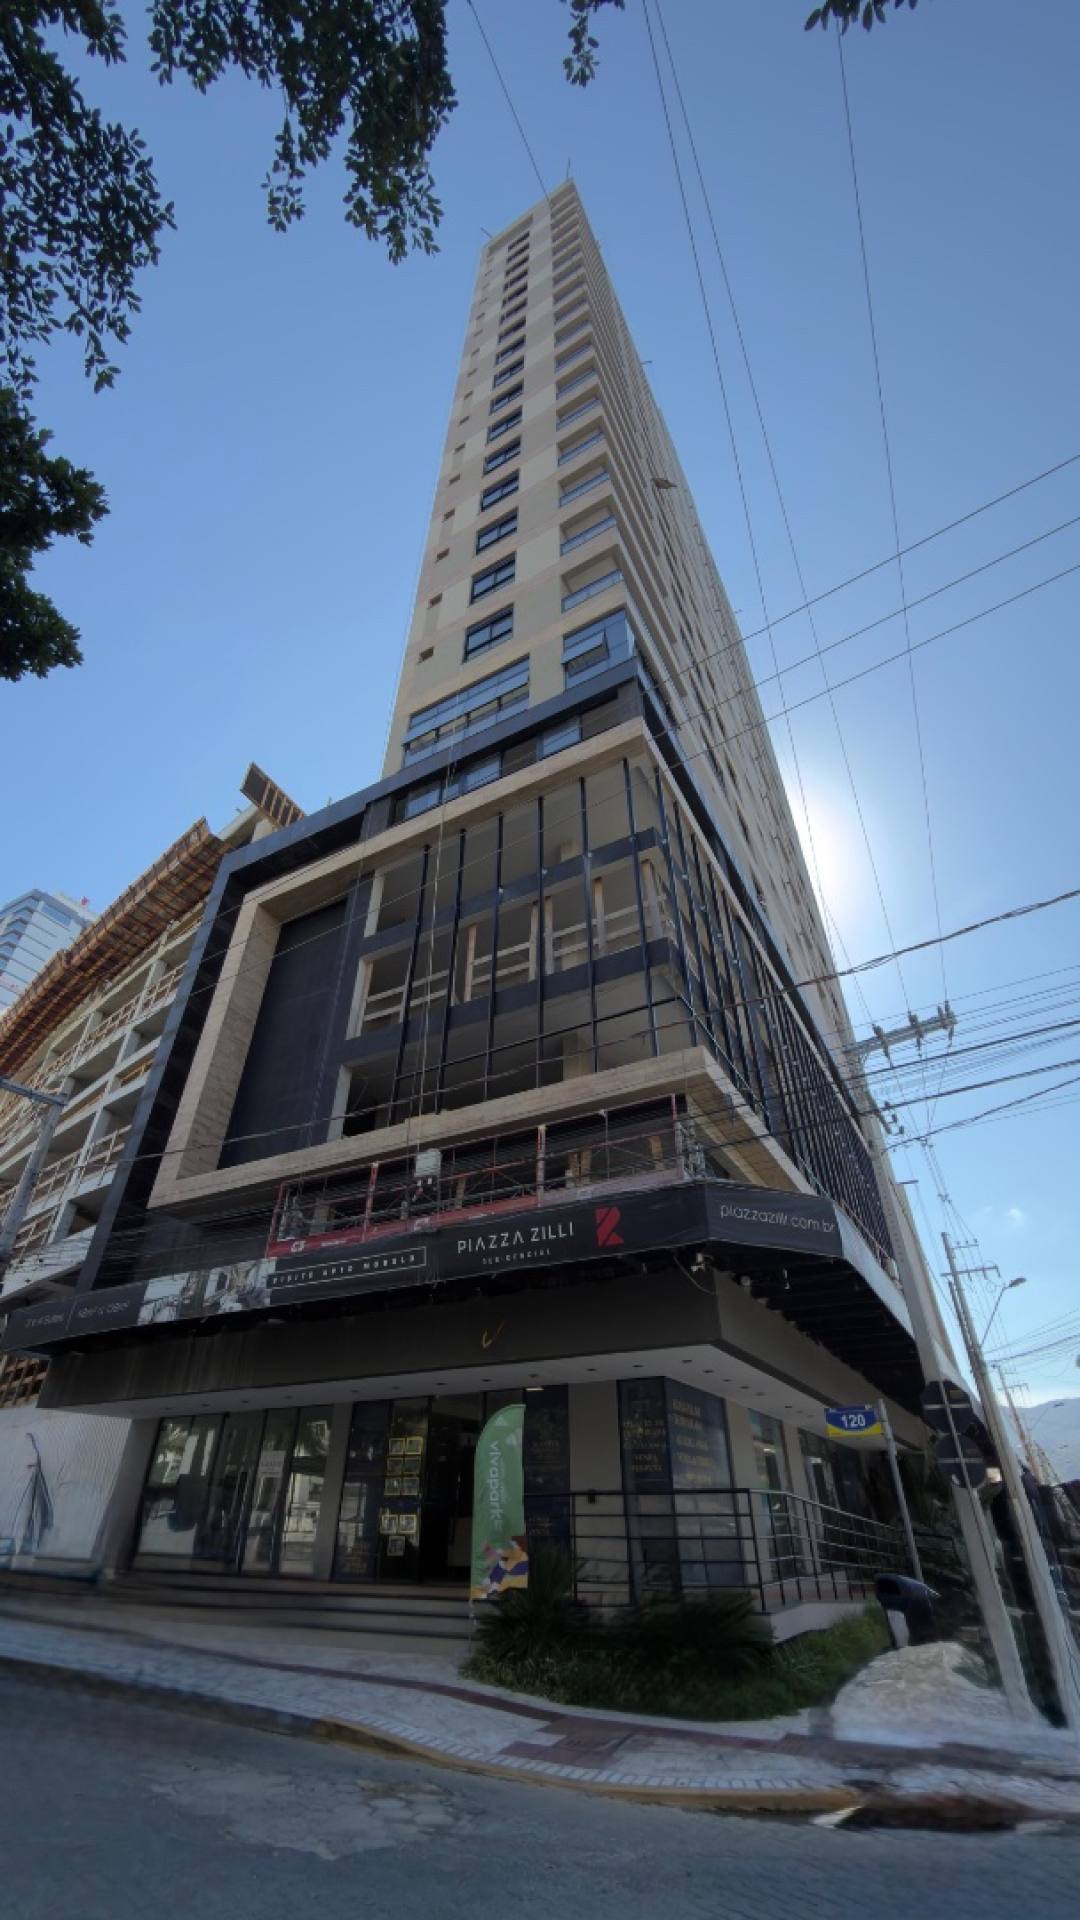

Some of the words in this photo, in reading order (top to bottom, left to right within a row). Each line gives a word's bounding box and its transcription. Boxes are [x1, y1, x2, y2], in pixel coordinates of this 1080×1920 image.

[457, 1231, 525, 1254] PIAZZA
[530, 1221, 575, 1242] ZILLI
[841, 1414, 866, 1429] 120
